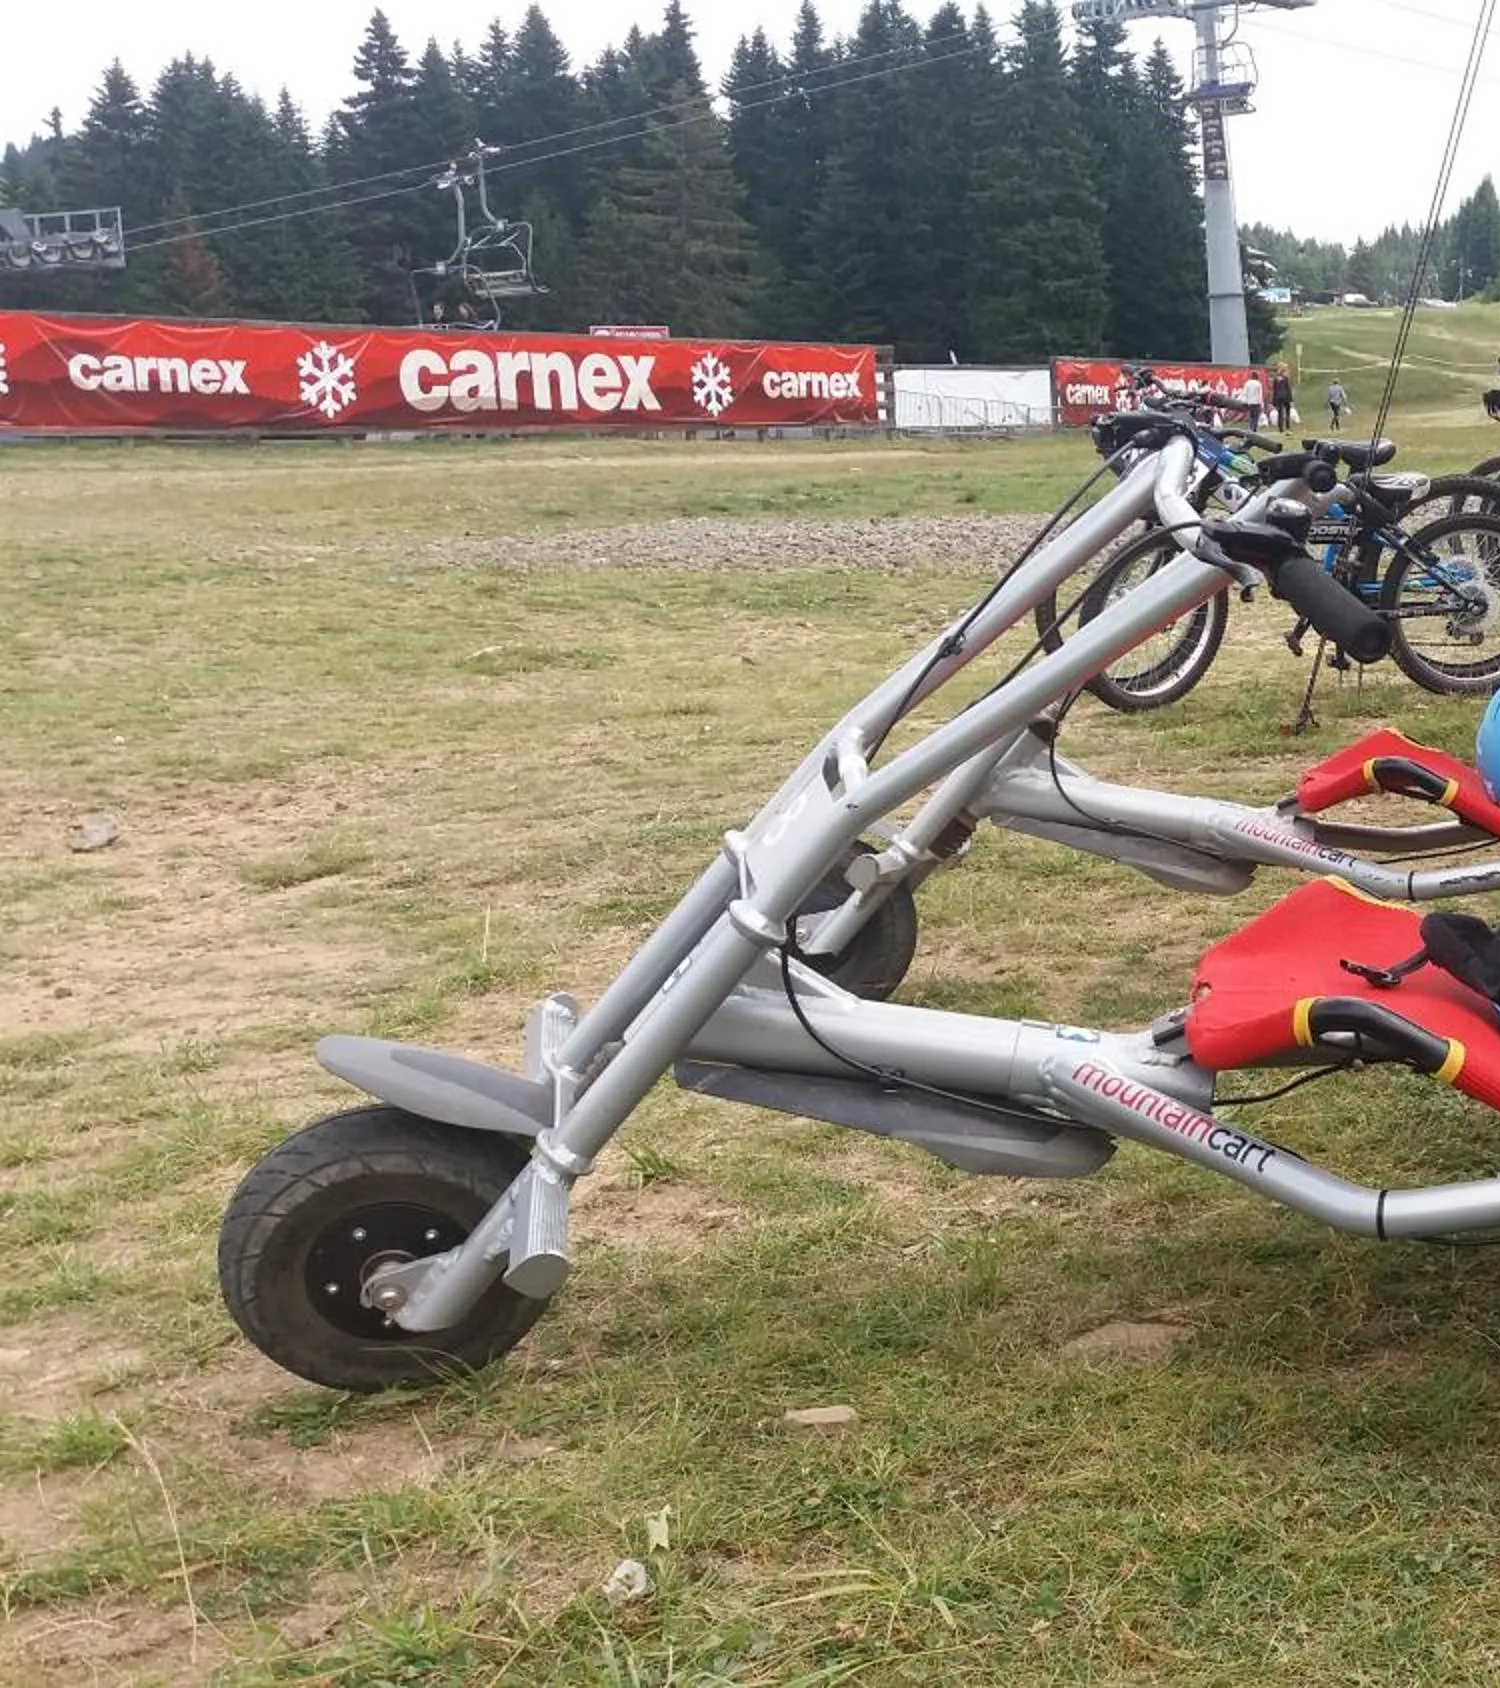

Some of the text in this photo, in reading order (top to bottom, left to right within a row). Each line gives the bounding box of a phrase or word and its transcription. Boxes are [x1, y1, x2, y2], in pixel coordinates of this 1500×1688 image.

[68, 353, 250, 394] carnex
[400, 349, 662, 412] carnex
[762, 370, 863, 399] carnex
[1065, 383, 1112, 405] carnex
[1234, 820, 1357, 868] mountaincart
[1071, 1062, 1276, 1173] mountaincart
